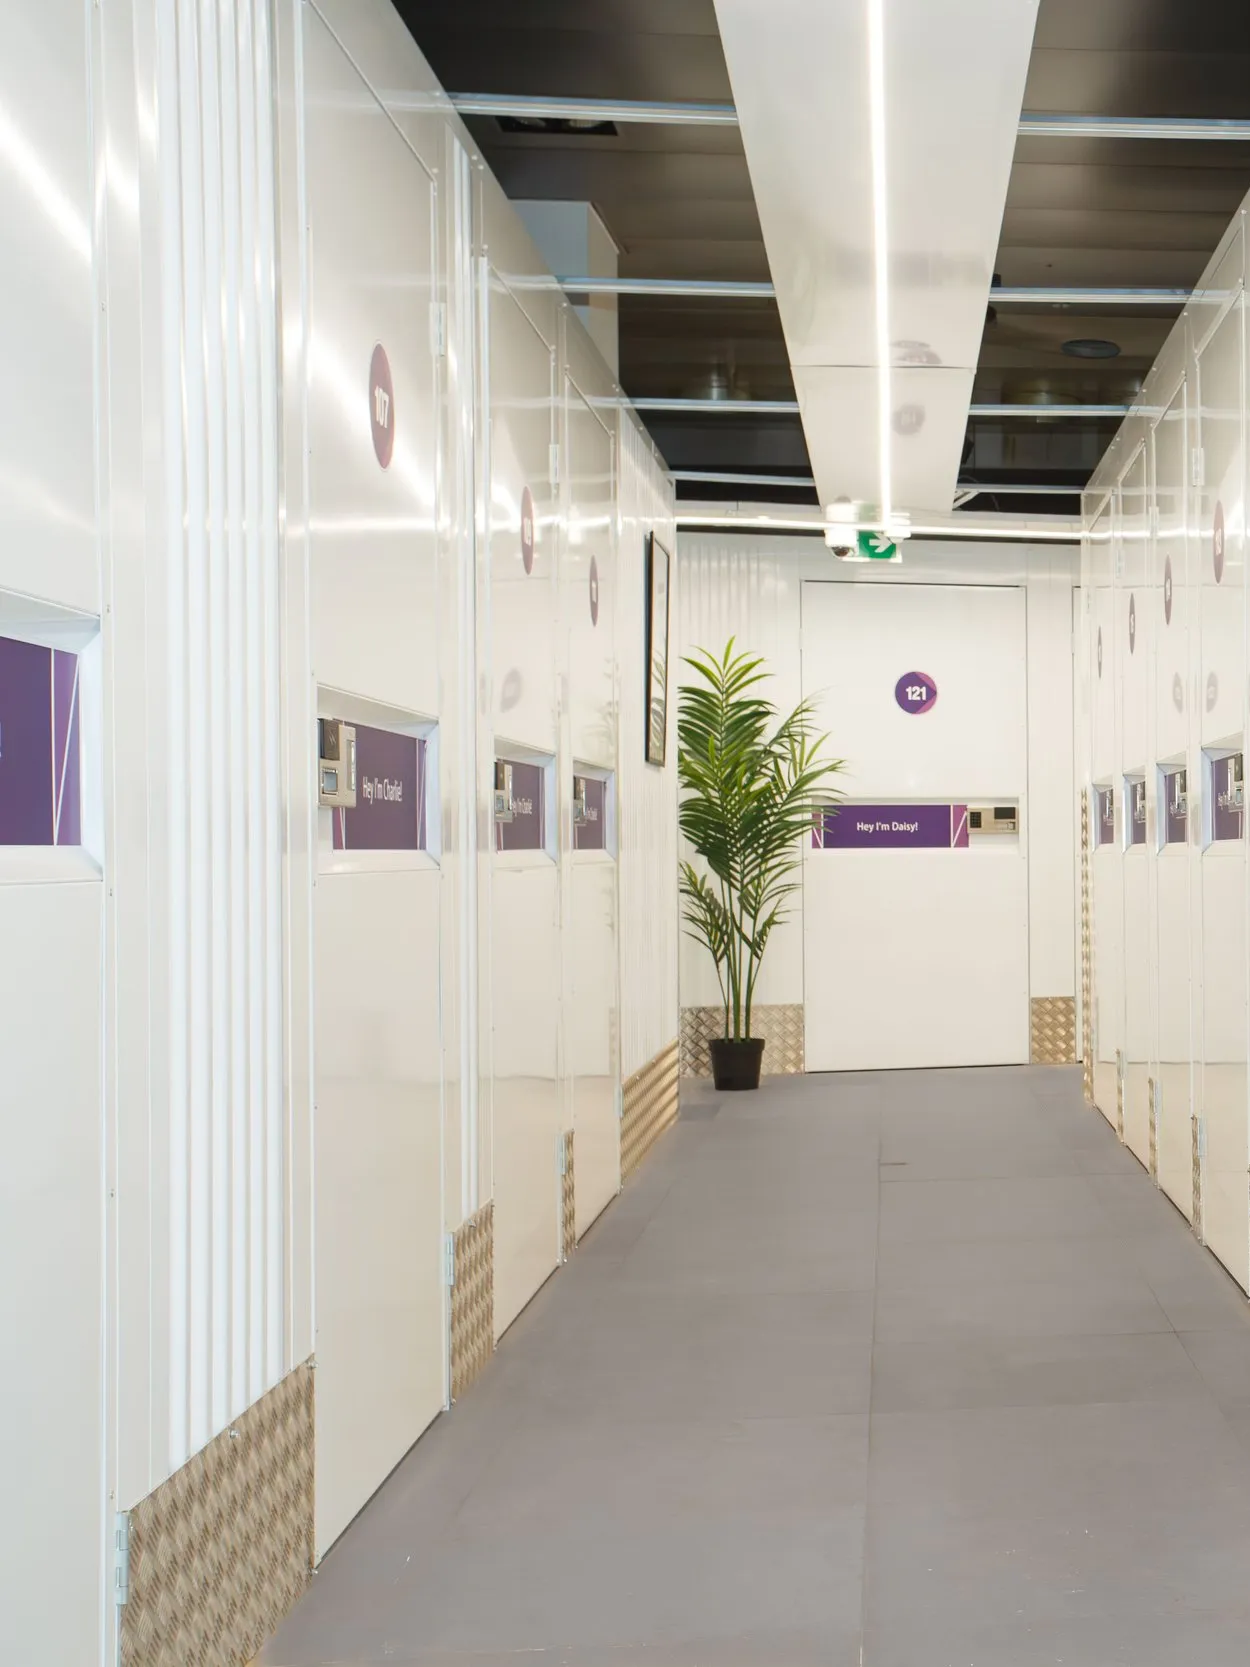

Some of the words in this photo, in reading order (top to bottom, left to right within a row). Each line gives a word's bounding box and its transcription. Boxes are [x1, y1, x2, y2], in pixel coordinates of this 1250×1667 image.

[374, 384, 389, 428] 107
[905, 685, 927, 701] 121
[363, 776, 373, 805] Hey
[374, 777, 383, 800] I'm
[383, 778, 403, 802] Charlie!
[856, 822, 874, 834] Hey
[876, 822, 890, 832] I'm
[892, 821, 919, 834] Daisy!
